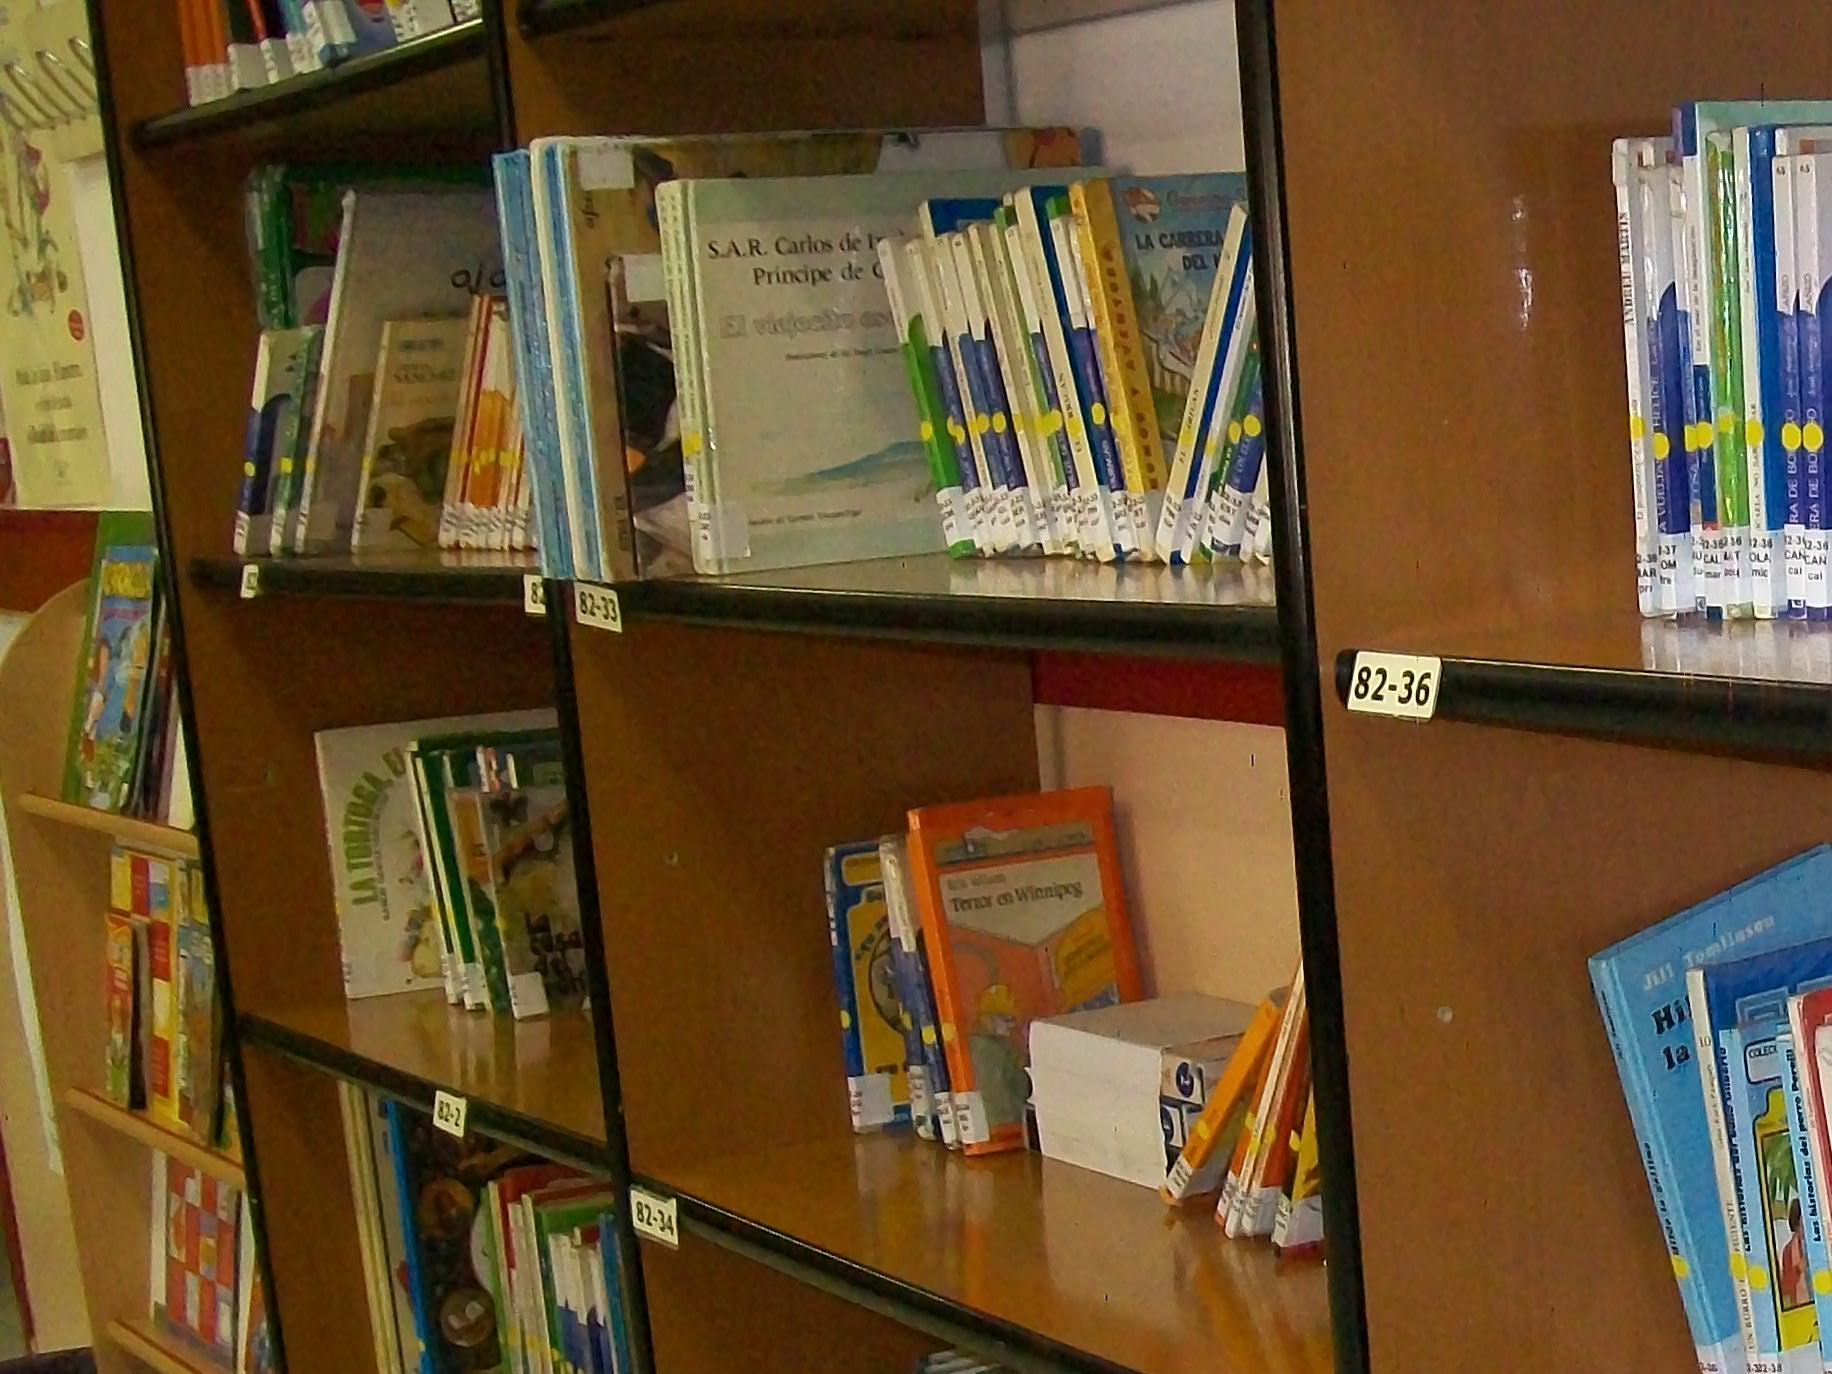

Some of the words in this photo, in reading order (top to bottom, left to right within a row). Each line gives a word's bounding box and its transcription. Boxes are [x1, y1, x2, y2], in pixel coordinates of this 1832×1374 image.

[707, 238, 768, 260] S.A.R.
[774, 234, 833, 256] Carlos
[839, 233, 862, 252] de
[1137, 232, 1155, 250] LA
[752, 264, 833, 287] Príncipe
[841, 262, 864, 281] de
[579, 592, 619, 623] 82-33
[1354, 666, 1432, 706] 82-36
[1643, 966, 1675, 991] Jill
[1684, 914, 1776, 968] Tomlinson
[636, 1202, 674, 1236] 82-34
